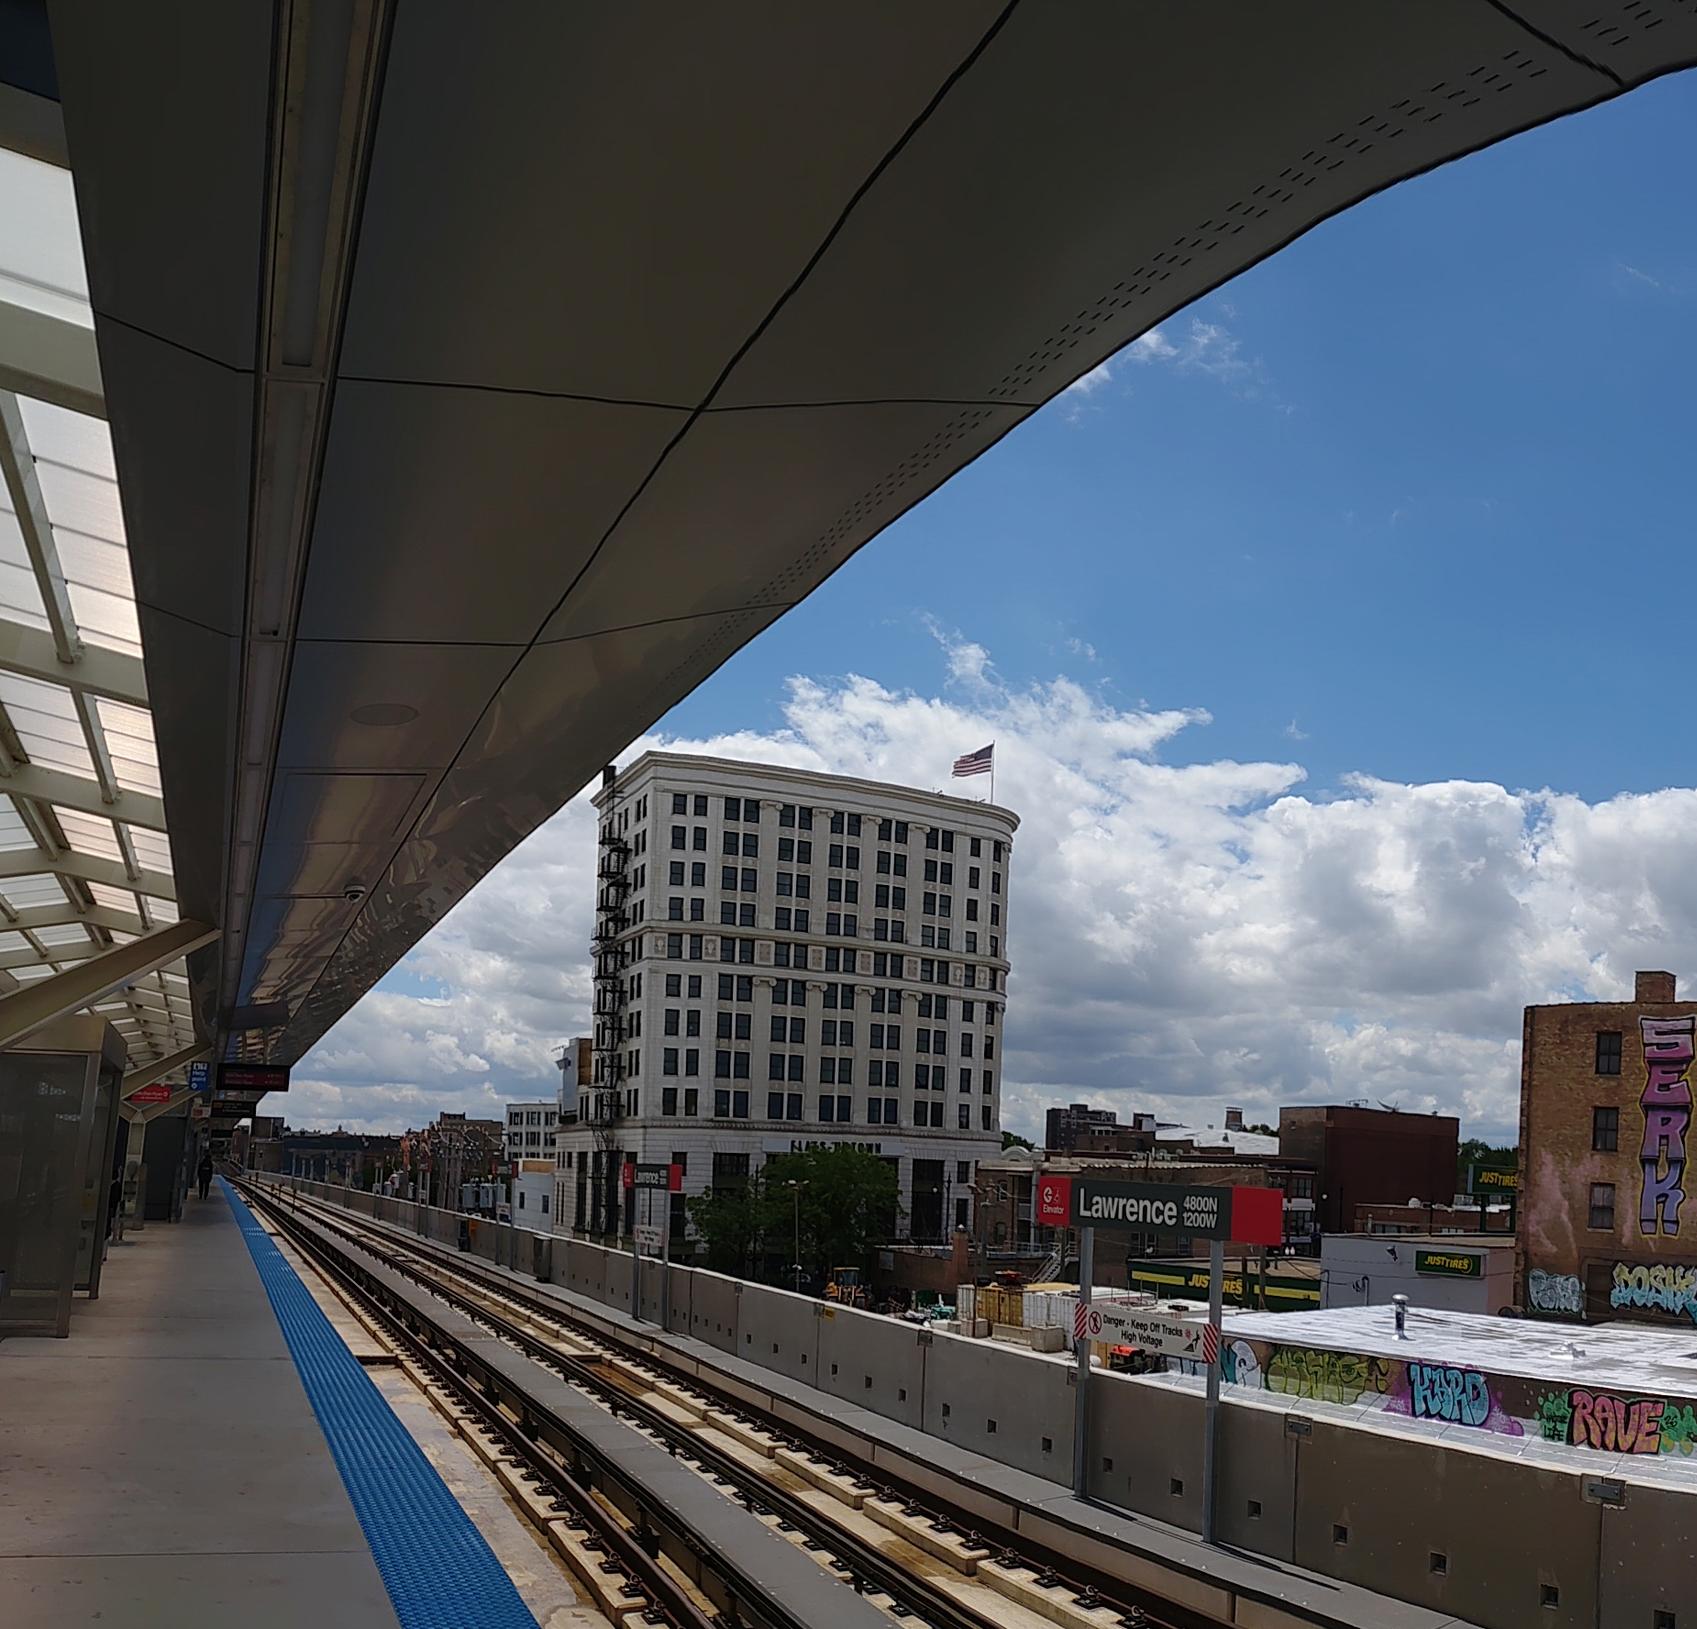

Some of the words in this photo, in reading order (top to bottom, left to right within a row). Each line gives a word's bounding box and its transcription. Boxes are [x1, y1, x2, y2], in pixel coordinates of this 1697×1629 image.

[1638, 1016, 1697, 1236] SERK
[1043, 1205, 1064, 1215] Elevator
[1079, 1187, 1177, 1226] Lawrence
[1183, 1195, 1218, 1213] 4800N
[1183, 1211, 1217, 1229] 1200W
[1103, 1314, 1125, 1328] Danger
[1131, 1318, 1148, 1332] Keep
[1150, 1321, 1160, 1332] Off
[1162, 1324, 1183, 1338] Tracks
[1121, 1330, 1136, 1342] High
[1138, 1333, 1163, 1348] Voltage
[1567, 1389, 1666, 1455] RAVE
